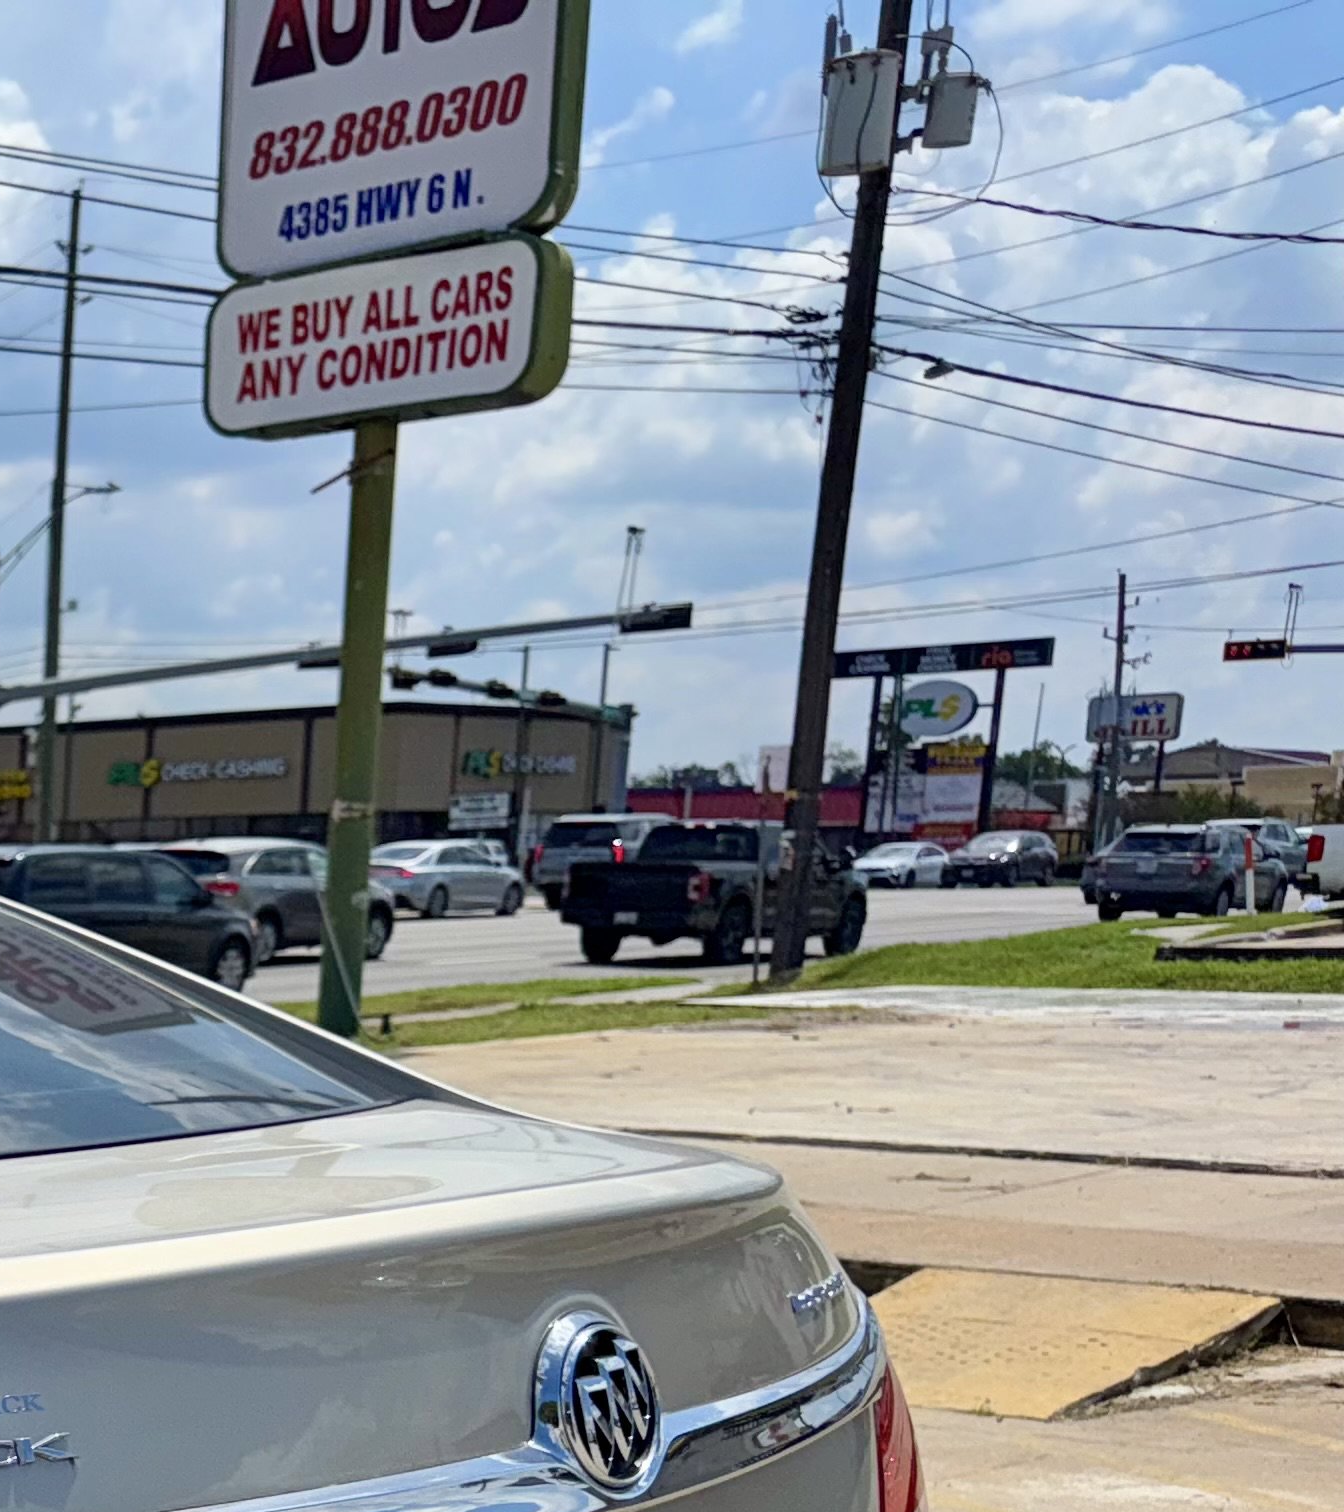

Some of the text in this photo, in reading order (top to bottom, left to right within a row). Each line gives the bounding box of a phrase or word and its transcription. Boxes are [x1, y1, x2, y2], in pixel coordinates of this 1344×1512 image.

[248, 73, 528, 180] 832.888.0300
[278, 193, 348, 242] 4385
[356, 177, 422, 228] HWY
[427, 173, 445, 214] 6
[238, 266, 513, 354] WE BUY ALL CARS
[237, 318, 509, 403] ANY CONDITION
